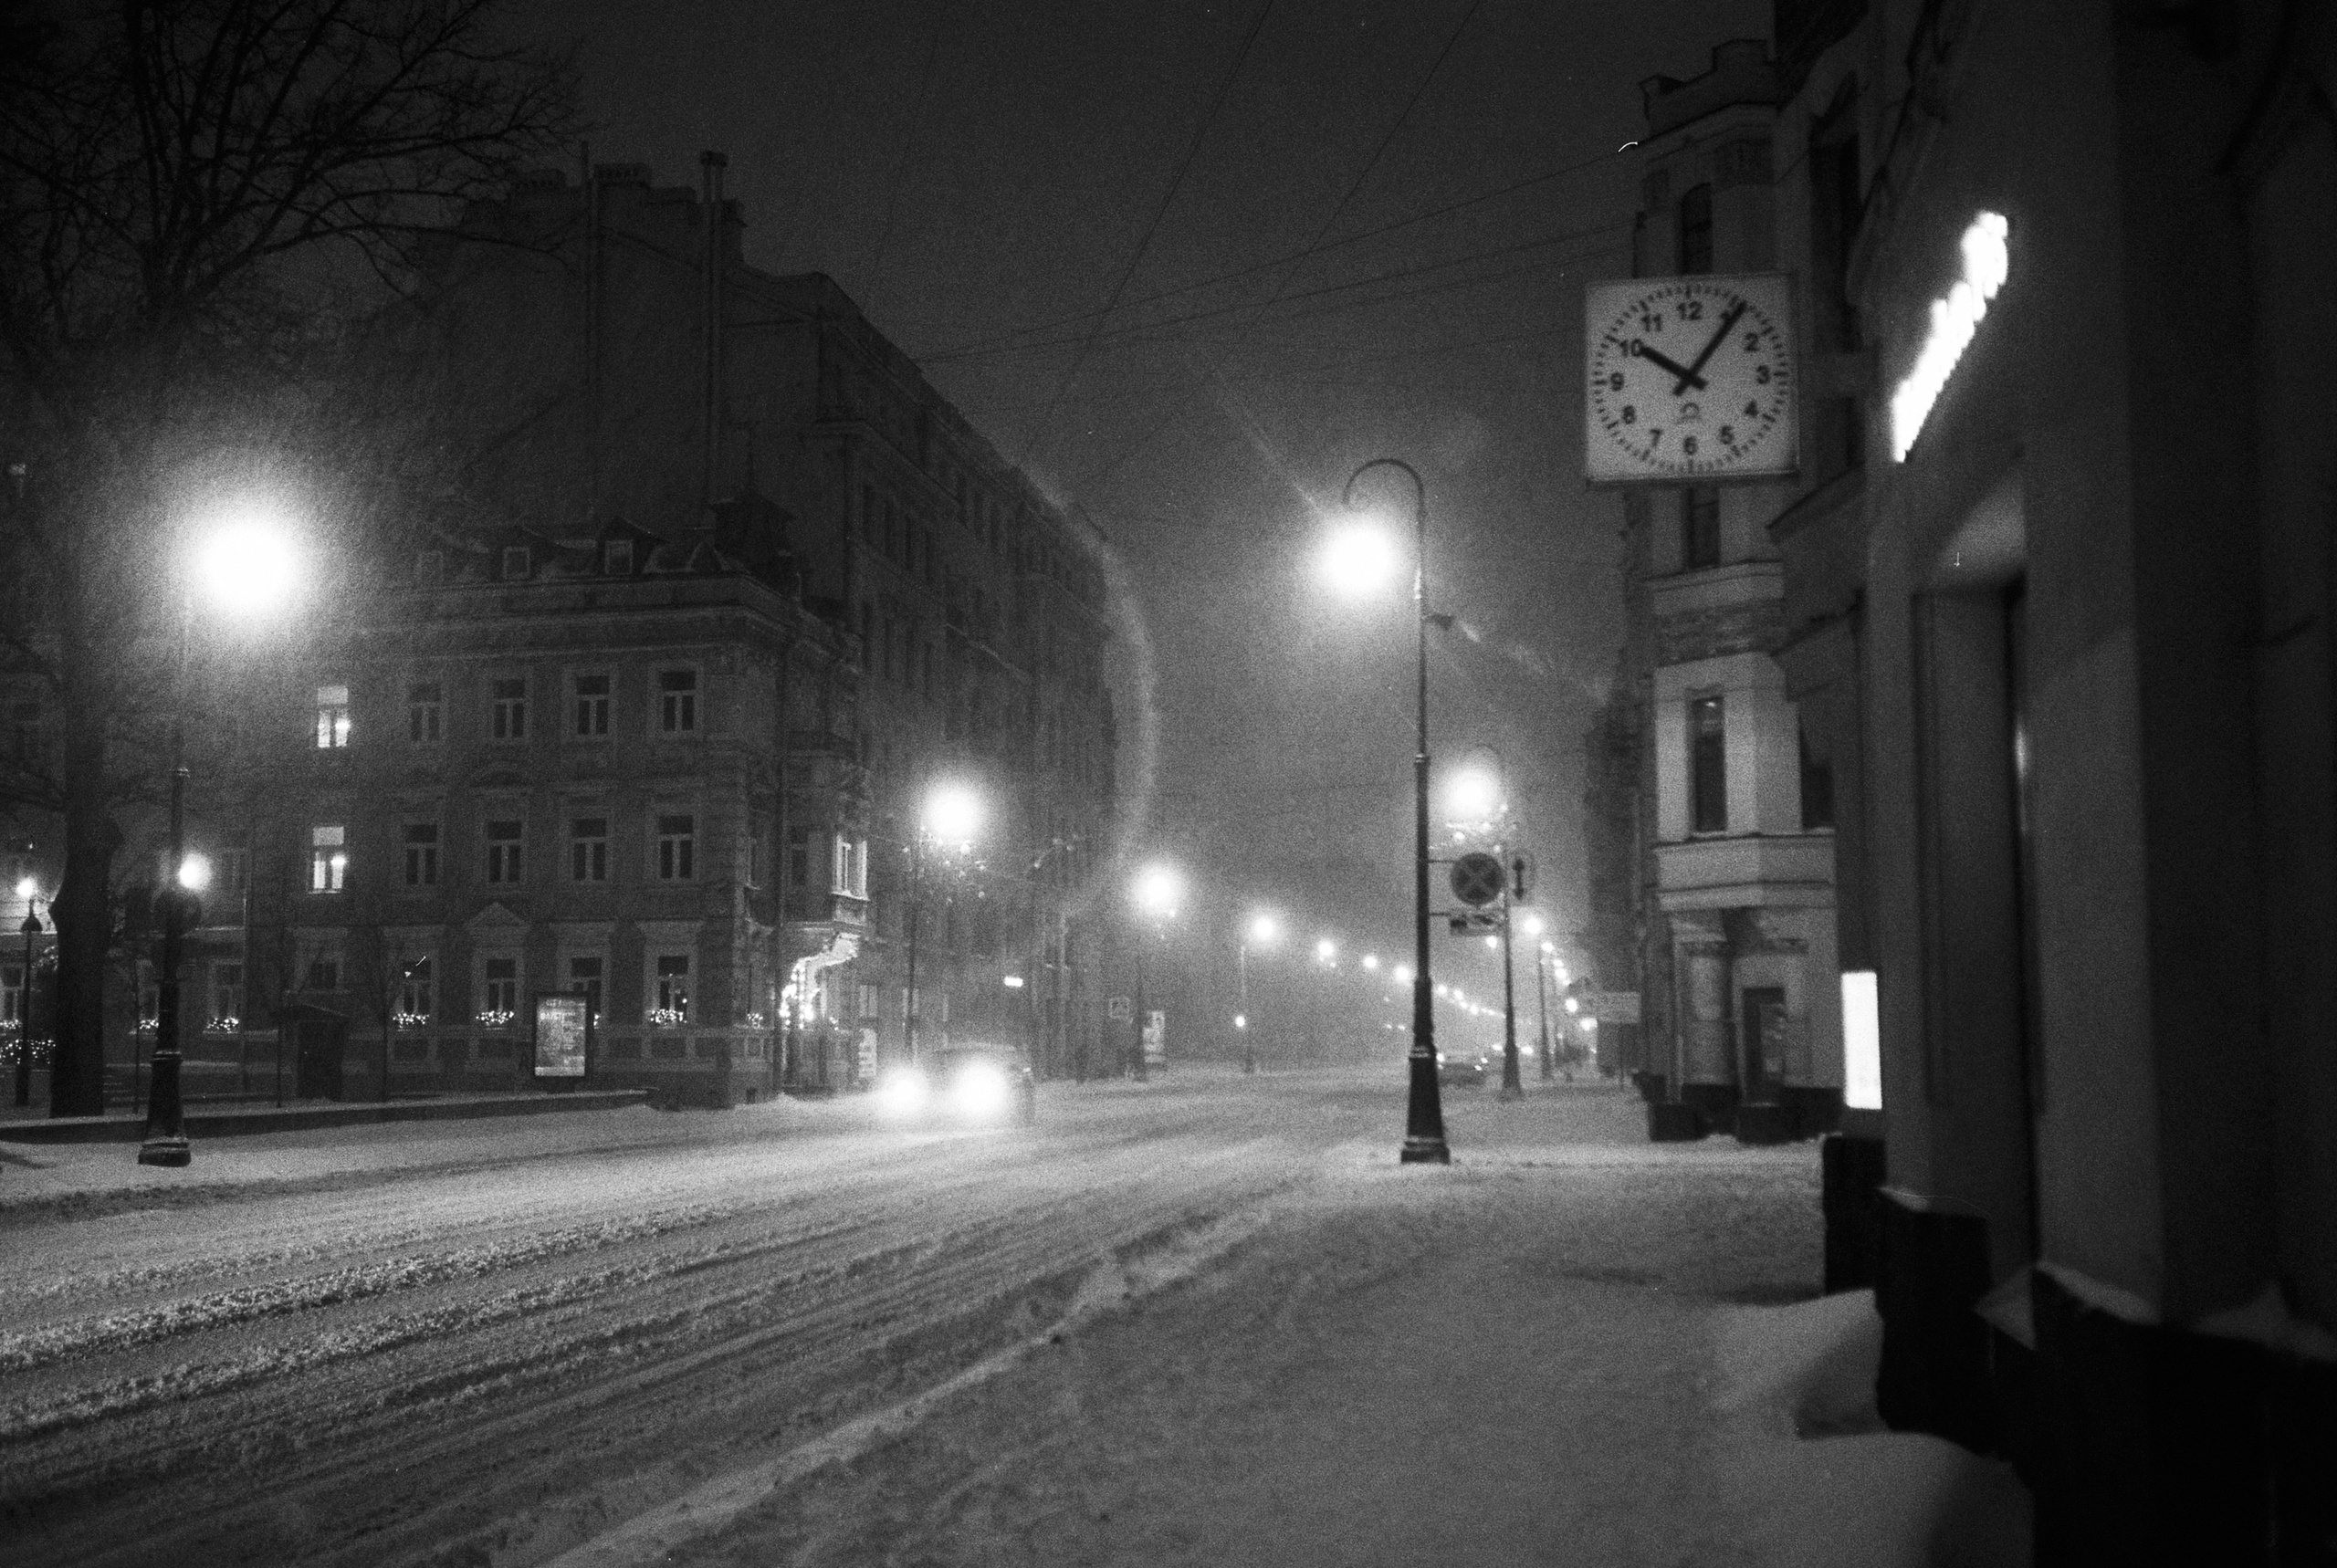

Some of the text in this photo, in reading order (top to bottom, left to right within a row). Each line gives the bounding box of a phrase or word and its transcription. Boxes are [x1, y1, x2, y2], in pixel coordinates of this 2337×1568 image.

[1677, 301, 1703, 320] 12
[1642, 314, 1662, 332] 11
[1620, 339, 1644, 358] 10
[1745, 332, 1758, 352] 2
[1610, 372, 1625, 392] 9
[1756, 365, 1770, 384] 3
[1622, 404, 1637, 425] 8
[1745, 400, 1758, 418] 4
[1650, 428, 1662, 447] 7
[1720, 425, 1734, 445] 5
[1682, 435, 1698, 455] 6
